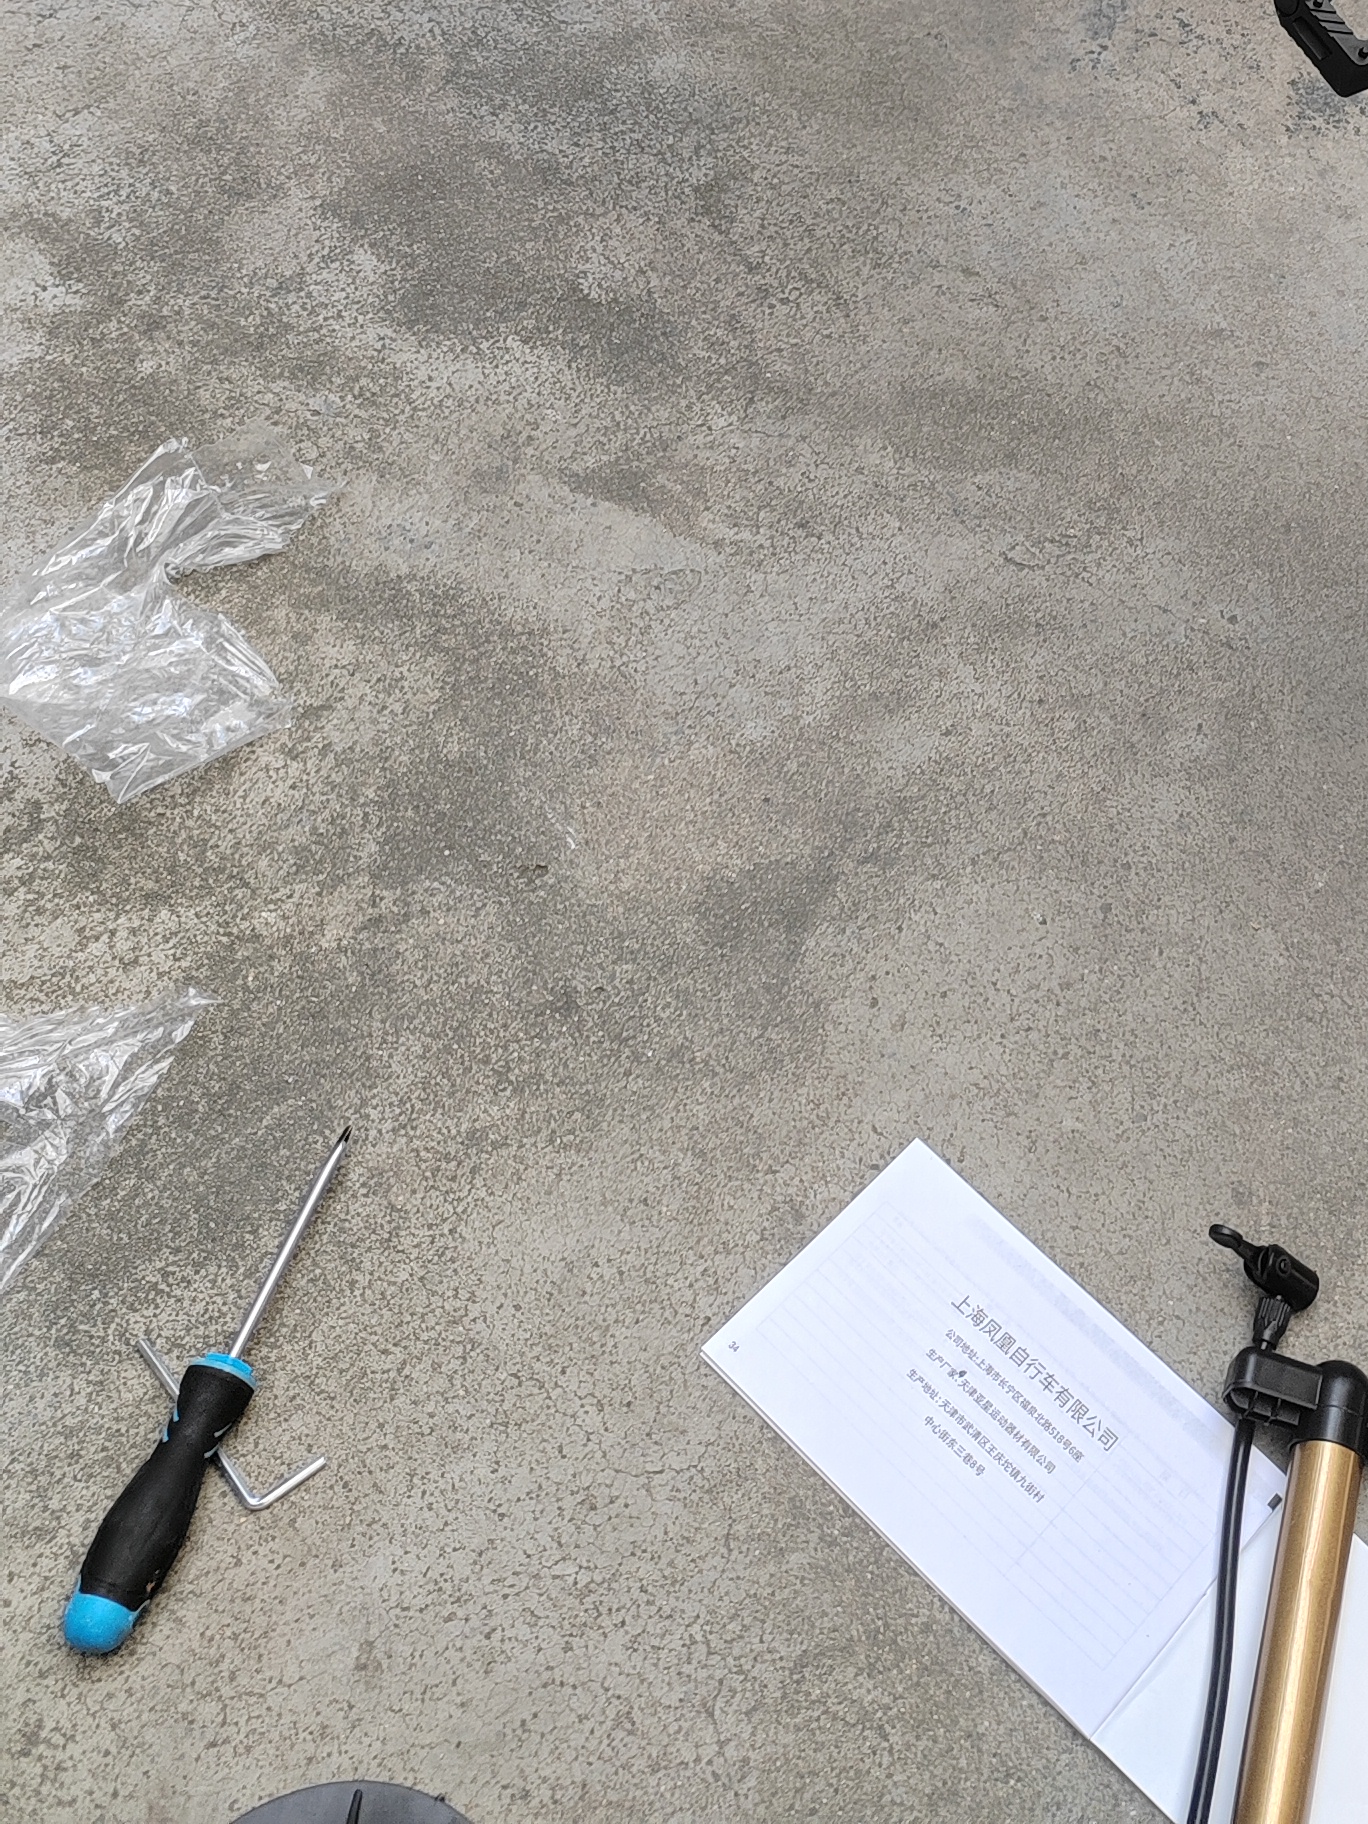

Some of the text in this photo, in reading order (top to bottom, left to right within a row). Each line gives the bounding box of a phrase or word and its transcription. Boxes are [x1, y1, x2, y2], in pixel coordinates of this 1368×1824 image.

[728, 1340, 740, 1352] 34
[951, 1295, 1119, 1452] 上海凤凰自行车有限公司
[924, 1415, 986, 1477] 中心街东三巷8号
